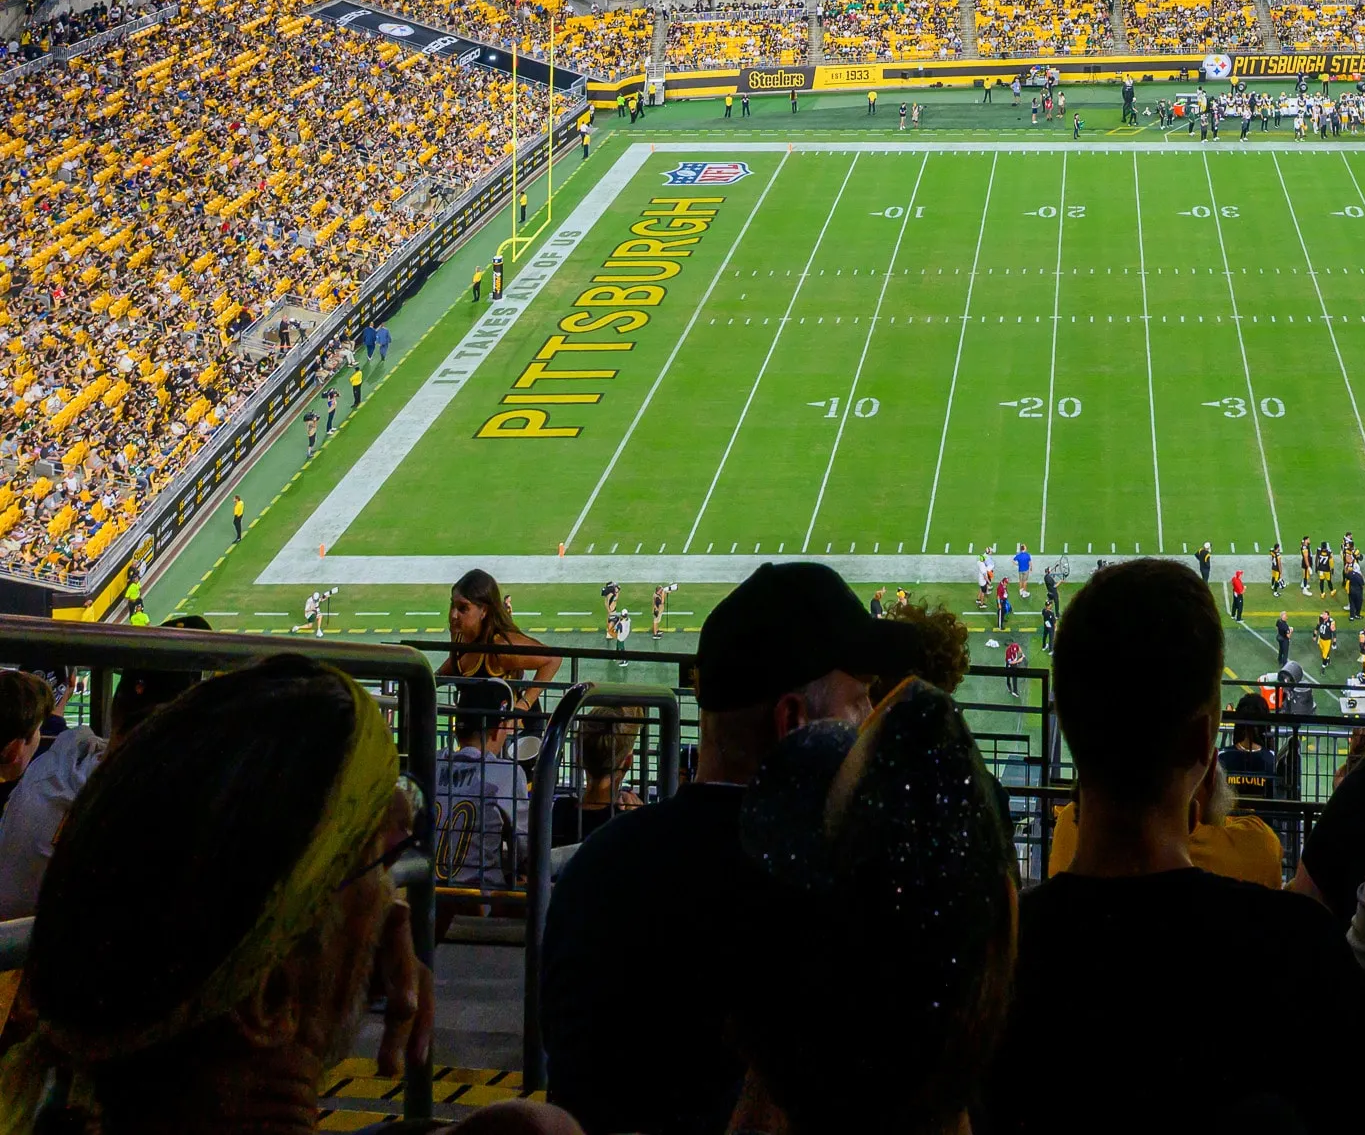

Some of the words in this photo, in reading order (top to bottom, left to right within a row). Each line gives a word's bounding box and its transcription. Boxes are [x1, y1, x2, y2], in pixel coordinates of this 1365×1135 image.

[335, 9, 372, 27] GEICO
[420, 36, 459, 54] GEICO
[459, 48, 481, 65] GEICO
[1233, 55, 1327, 74] PITTSBURGH
[749, 70, 805, 88] Steelers
[846, 70, 870, 80] 1933
[698, 164, 740, 182] NFL
[432, 368, 467, 385] IT
[453, 306, 518, 360] TAKES
[505, 274, 547, 301] ALL
[533, 252, 562, 268] OF
[551, 230, 582, 247] US
[474, 196, 726, 439] PITTSBURGH
[822, 397, 881, 418] 10
[1016, 397, 1082, 418] 20
[1219, 397, 1287, 418] 30
[1319, 556, 1329, 565] 77
